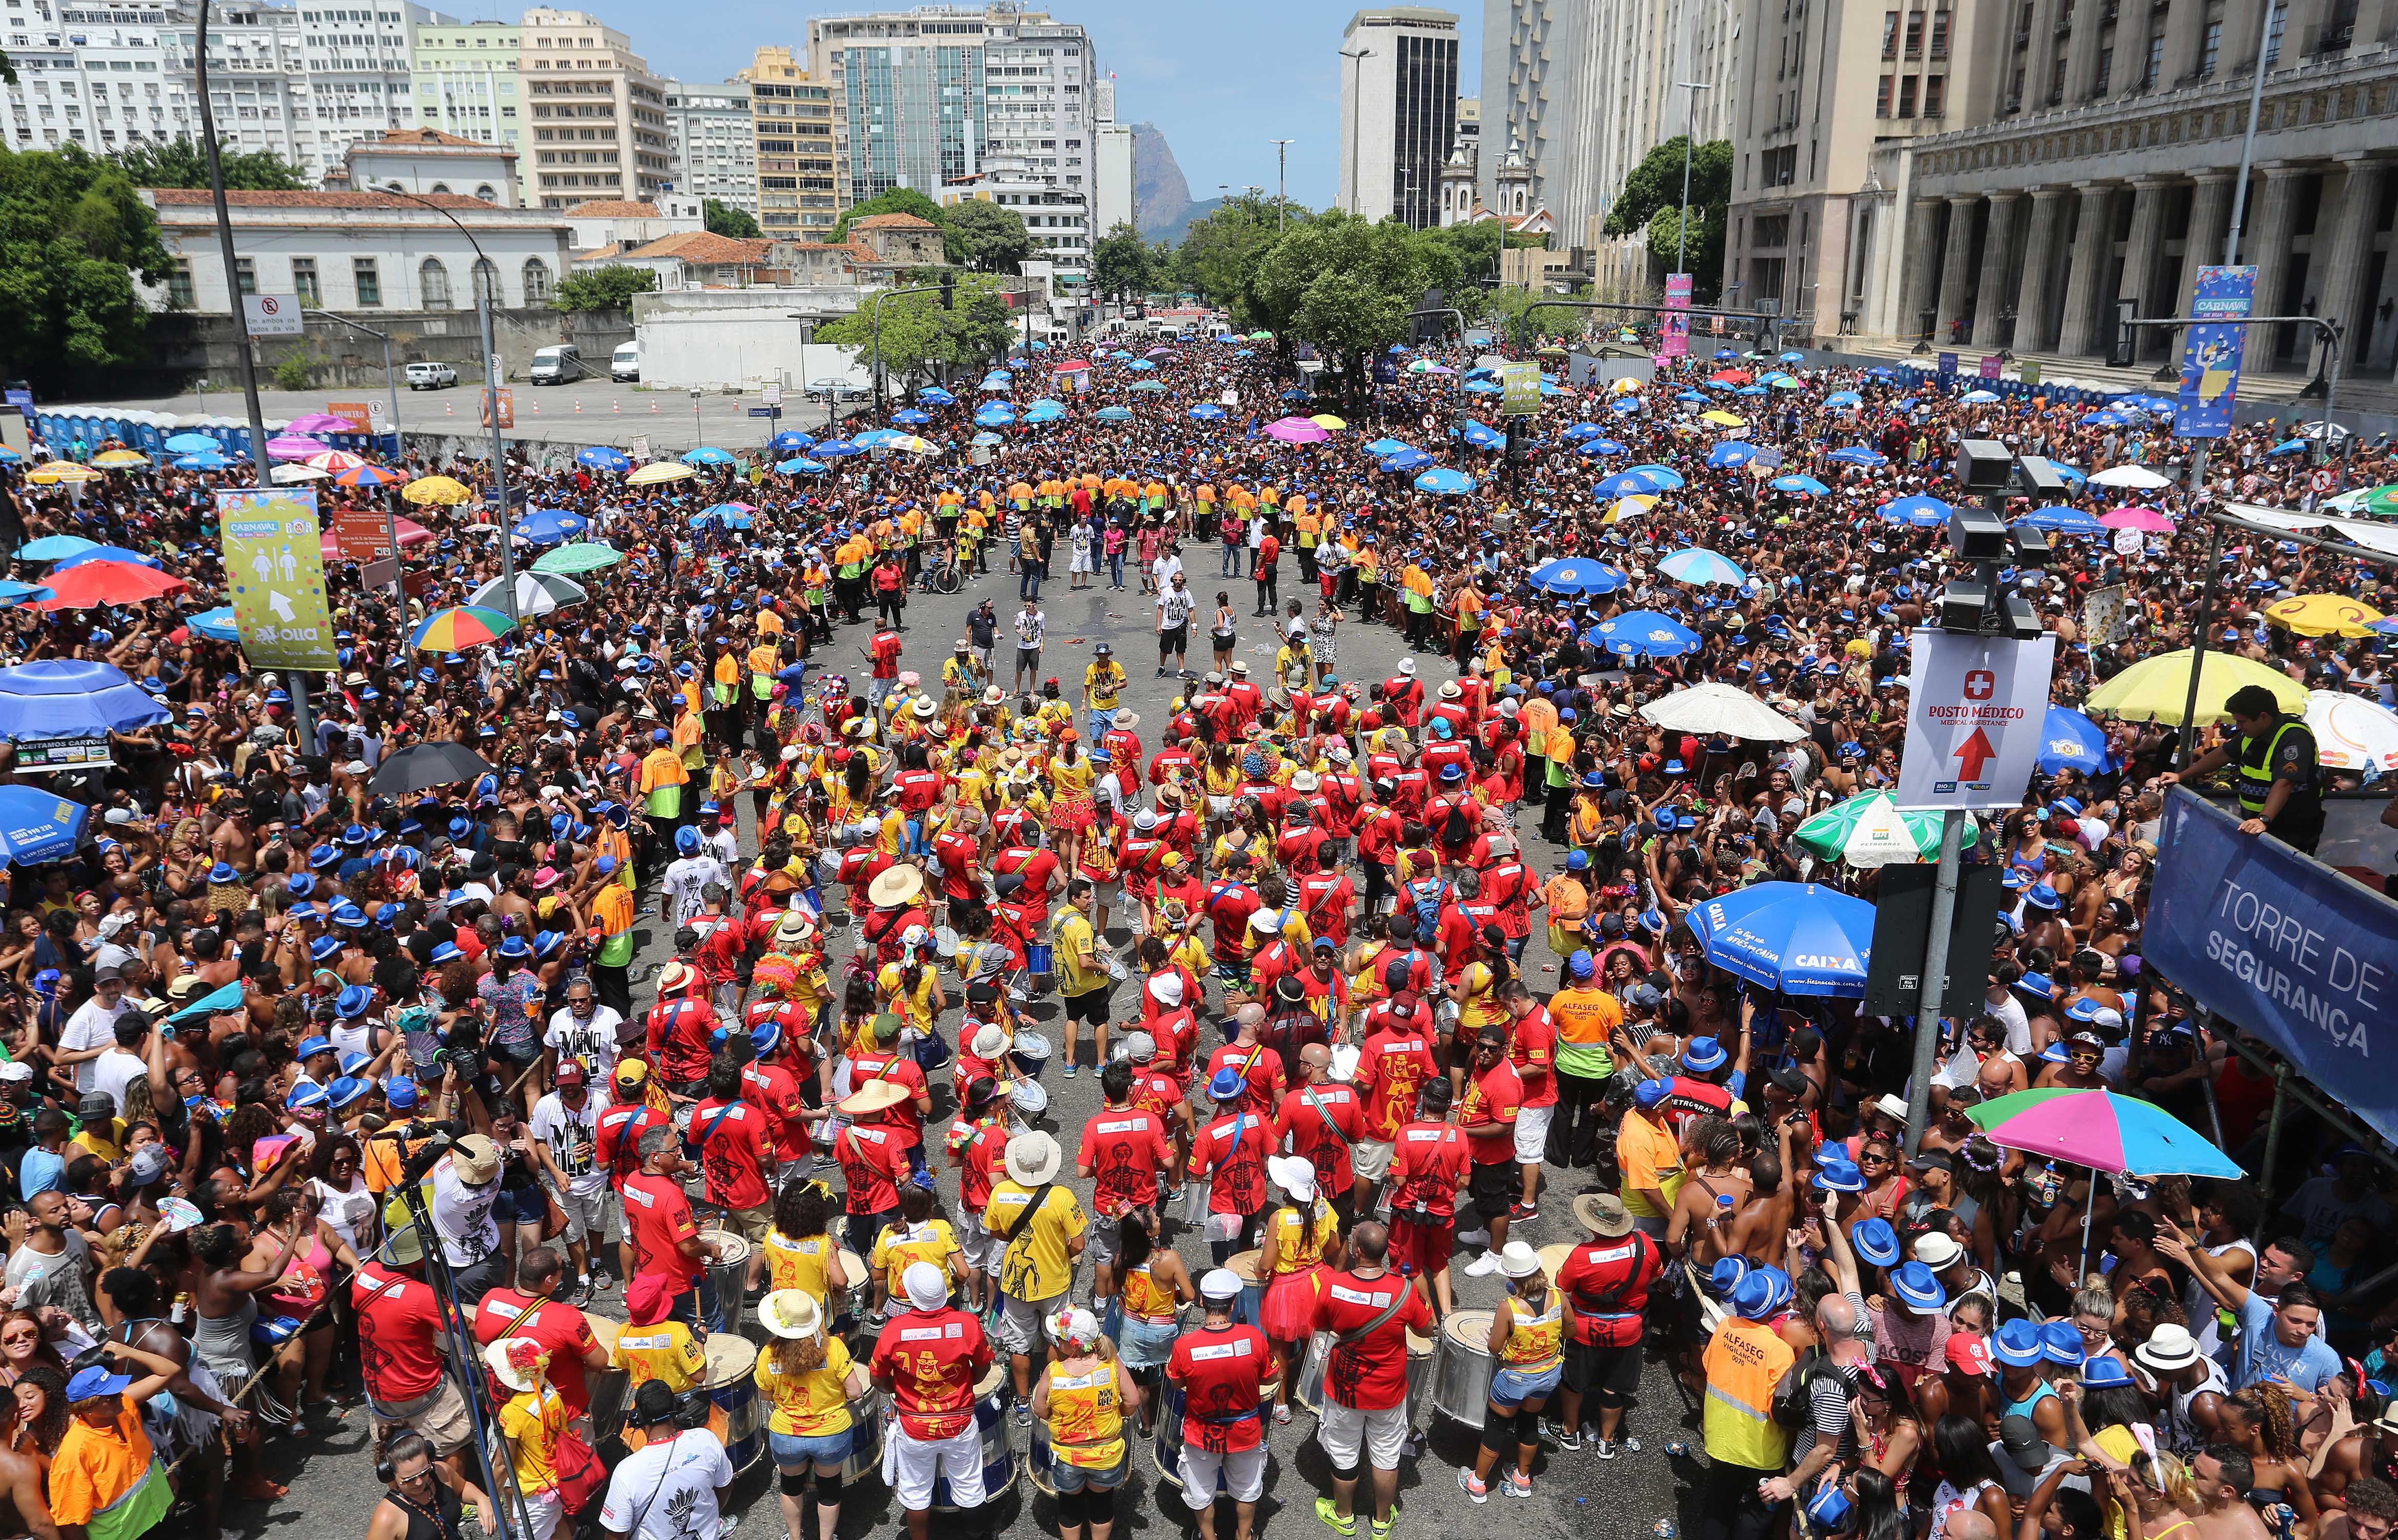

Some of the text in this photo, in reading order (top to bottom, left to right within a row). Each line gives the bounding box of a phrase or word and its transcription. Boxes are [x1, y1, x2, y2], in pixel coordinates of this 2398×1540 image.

[2198, 302, 2247, 311] CARNAVAL
[230, 523, 277, 532] CARNAVAL
[280, 627, 320, 641] olla
[1648, 630, 1675, 642] BOA
[1928, 704, 2024, 719] POSTO MÉDICO
[15, 738, 107, 751] ACEITAMOS CARTÕES
[2052, 742, 2084, 757] BOA
[2319, 754, 2347, 763] MasterCard
[11, 830, 28, 841] 0800
[27, 827, 41, 837] 990
[41, 823, 53, 832] 220
[1707, 902, 1728, 933] CAIXA
[1756, 936, 1765, 944] no
[2219, 878, 2385, 1011] TORRE DE
[1795, 954, 1858, 971] CAIXA
[1787, 977, 1865, 988] www.fiesnacaixa.com.br
[2206, 929, 2369, 1058] SEGURANÇA
[1562, 1003, 1599, 1012] ALFASEG
[1373, 1296, 1389, 1306] BOA
[946, 1328, 961, 1337] BOA
[655, 1339, 670, 1348] BOA
[1723, 1331, 1765, 1361] ALFASEG
[1236, 1345, 1251, 1355] BOA
[1731, 1355, 1745, 1367] 0070
[1094, 1376, 1109, 1385] BOA
